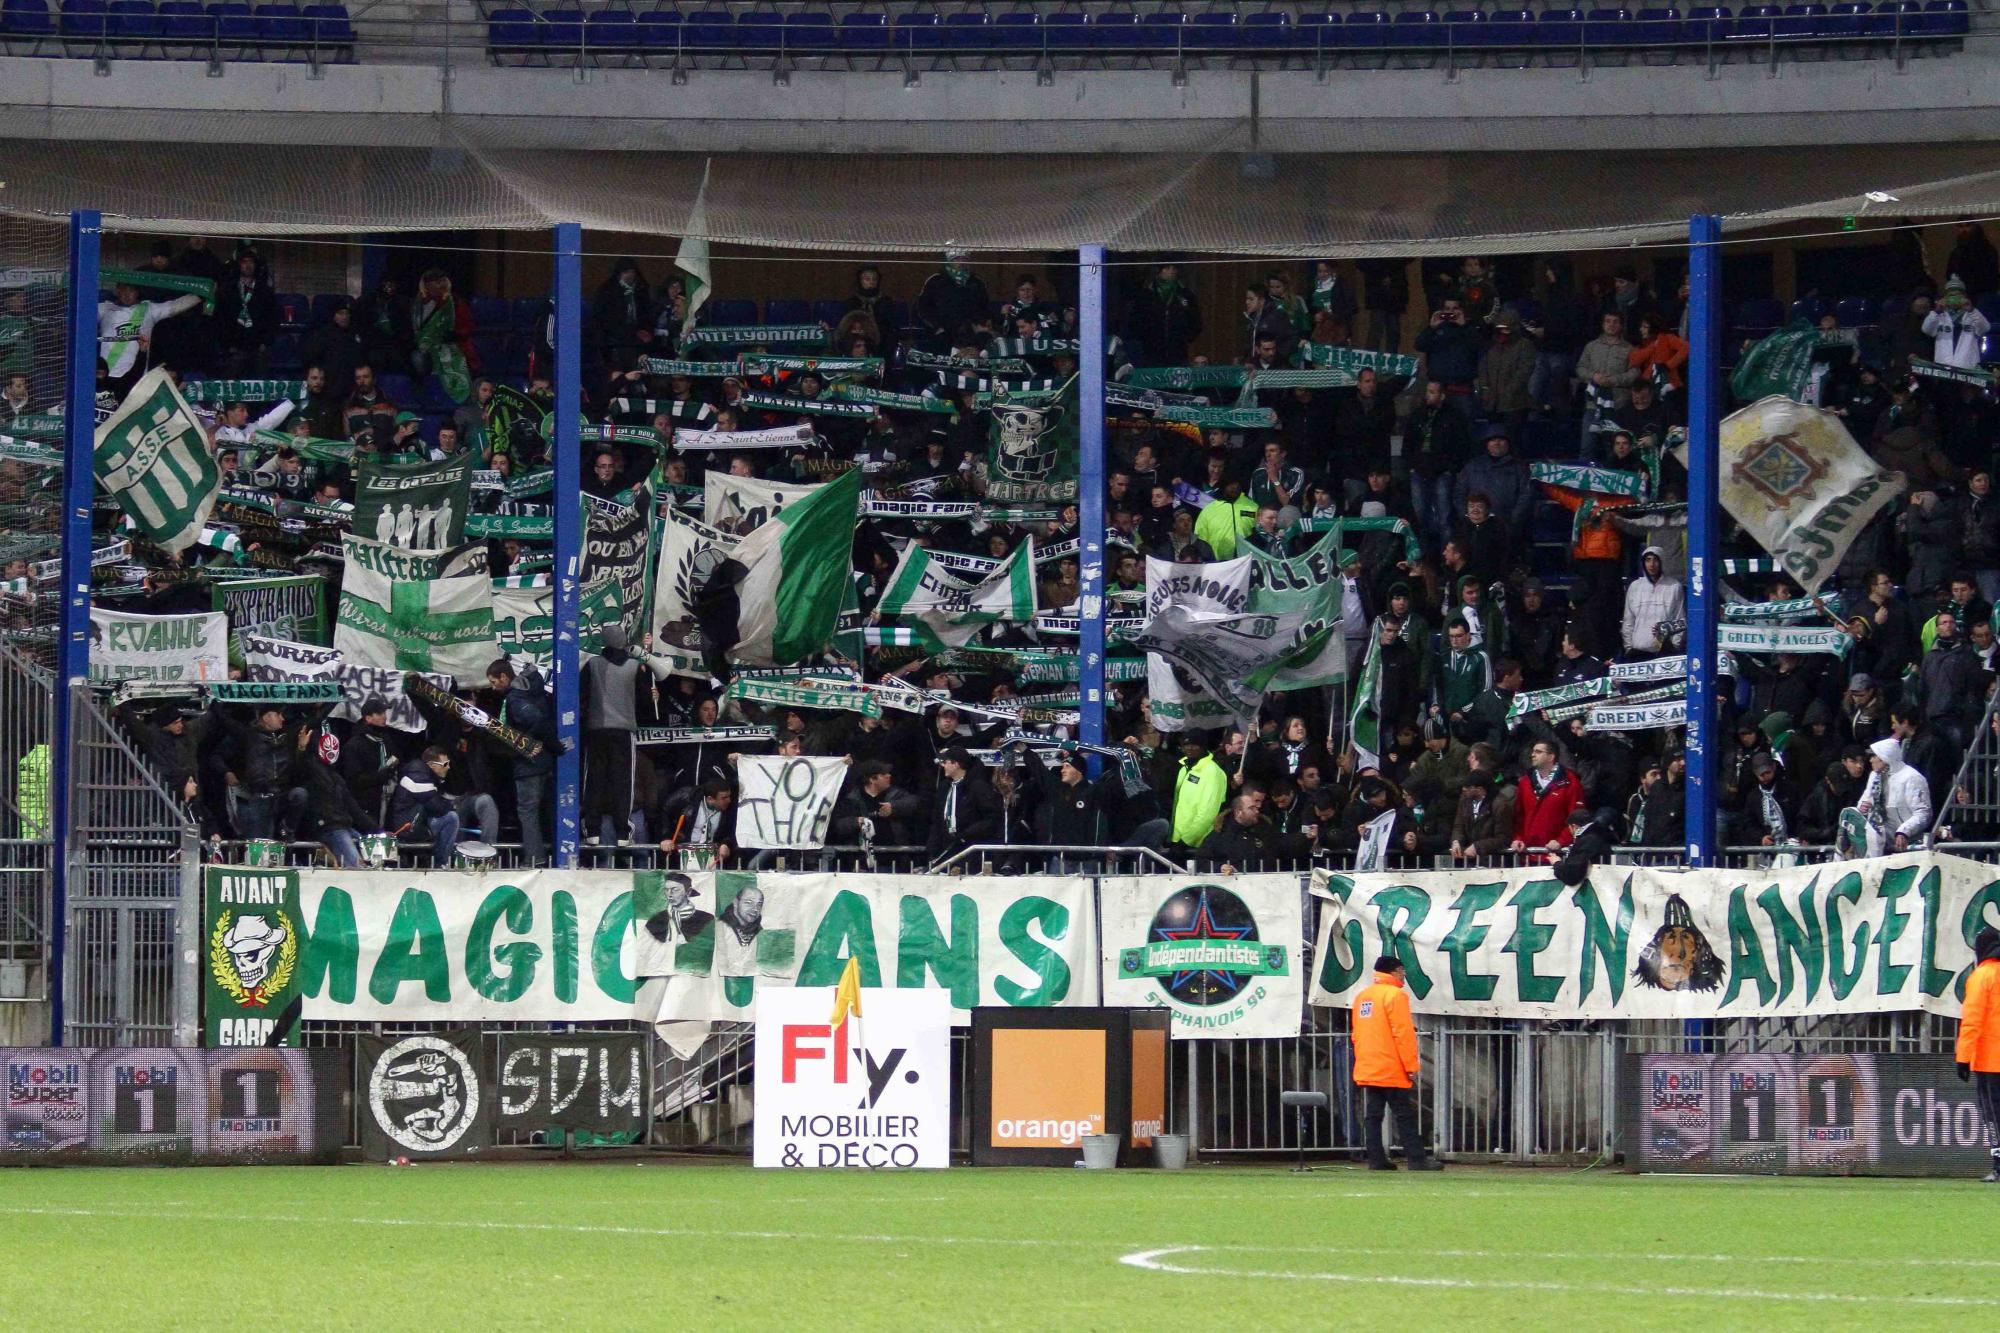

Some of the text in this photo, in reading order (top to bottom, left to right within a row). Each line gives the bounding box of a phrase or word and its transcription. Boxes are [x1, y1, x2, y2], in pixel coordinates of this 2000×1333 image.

[1033, 541, 1073, 560] agic
[340, 597, 386, 634] Ultras
[454, 618, 492, 638] nord
[1728, 632, 1828, 645] GREEN ANGELS
[218, 682, 334, 700] MAGIC FANS
[1596, 707, 1647, 724] GREEN
[758, 756, 816, 803] YO
[220, 875, 287, 904] AVANT
[300, 884, 1071, 1009] MAGIC ANS
[1319, 872, 1634, 1009] GREEN
[1144, 985, 1268, 1028] STPHANOIS 98
[8, 1063, 79, 1085] Mobil
[1652, 1070, 1703, 1091] Mobil
[8, 1083, 79, 1101] Super
[236, 1072, 258, 1117] 1
[1652, 1090, 1703, 1109] Super
[1820, 1078, 1837, 1124] 1
[133, 1088, 155, 1133] 1
[1743, 1095, 1760, 1140] 1
[780, 1114, 919, 1139] MOBILIER
[997, 1118, 1093, 1145] orange
[1133, 1119, 1161, 1139] orange
[780, 1140, 919, 1168] & DÉCO
